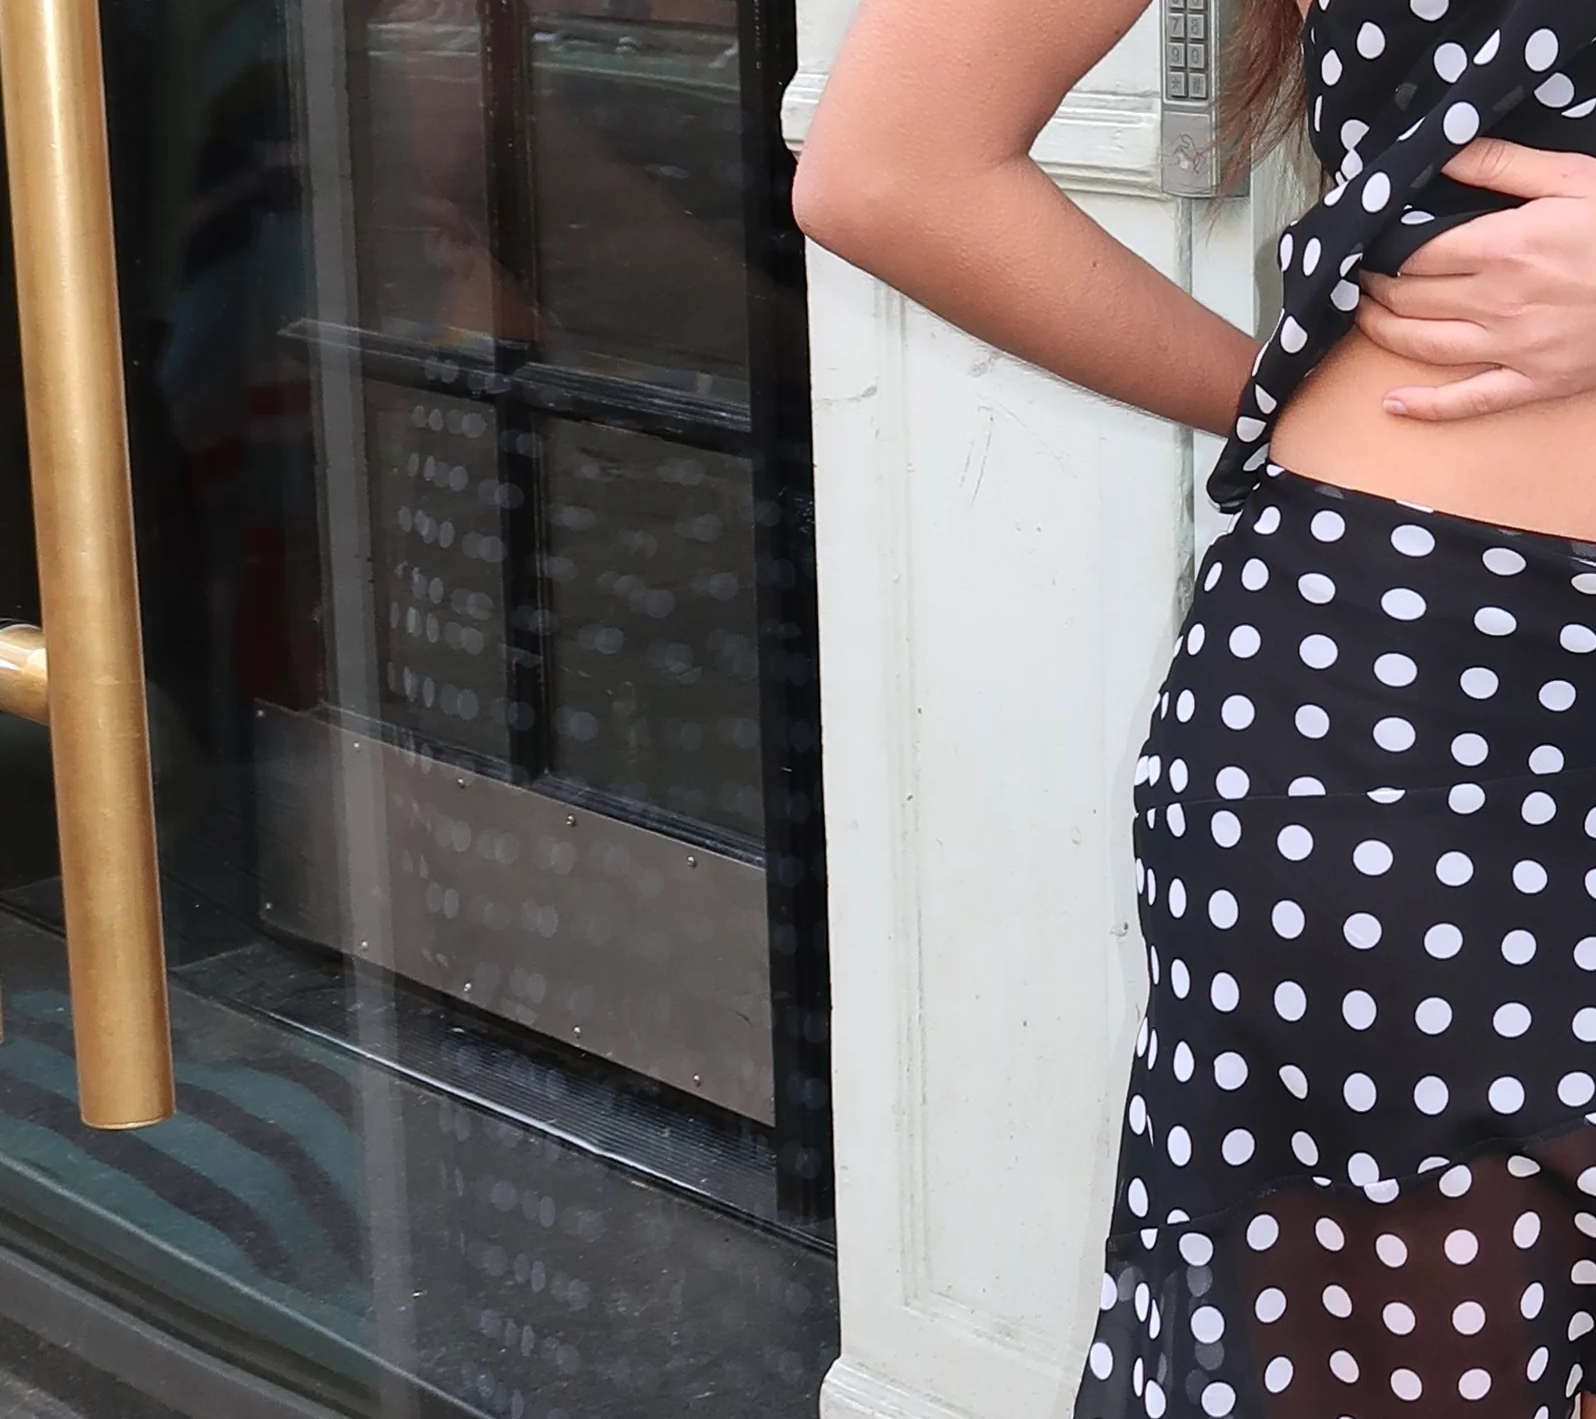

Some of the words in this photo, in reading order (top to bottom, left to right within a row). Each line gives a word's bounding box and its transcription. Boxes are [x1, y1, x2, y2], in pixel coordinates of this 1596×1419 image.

[1171, 16, 1179, 33] 7
[1190, 18, 1199, 35] 8
[1171, 46, 1180, 62] 9
[1191, 47, 1200, 64] 0
